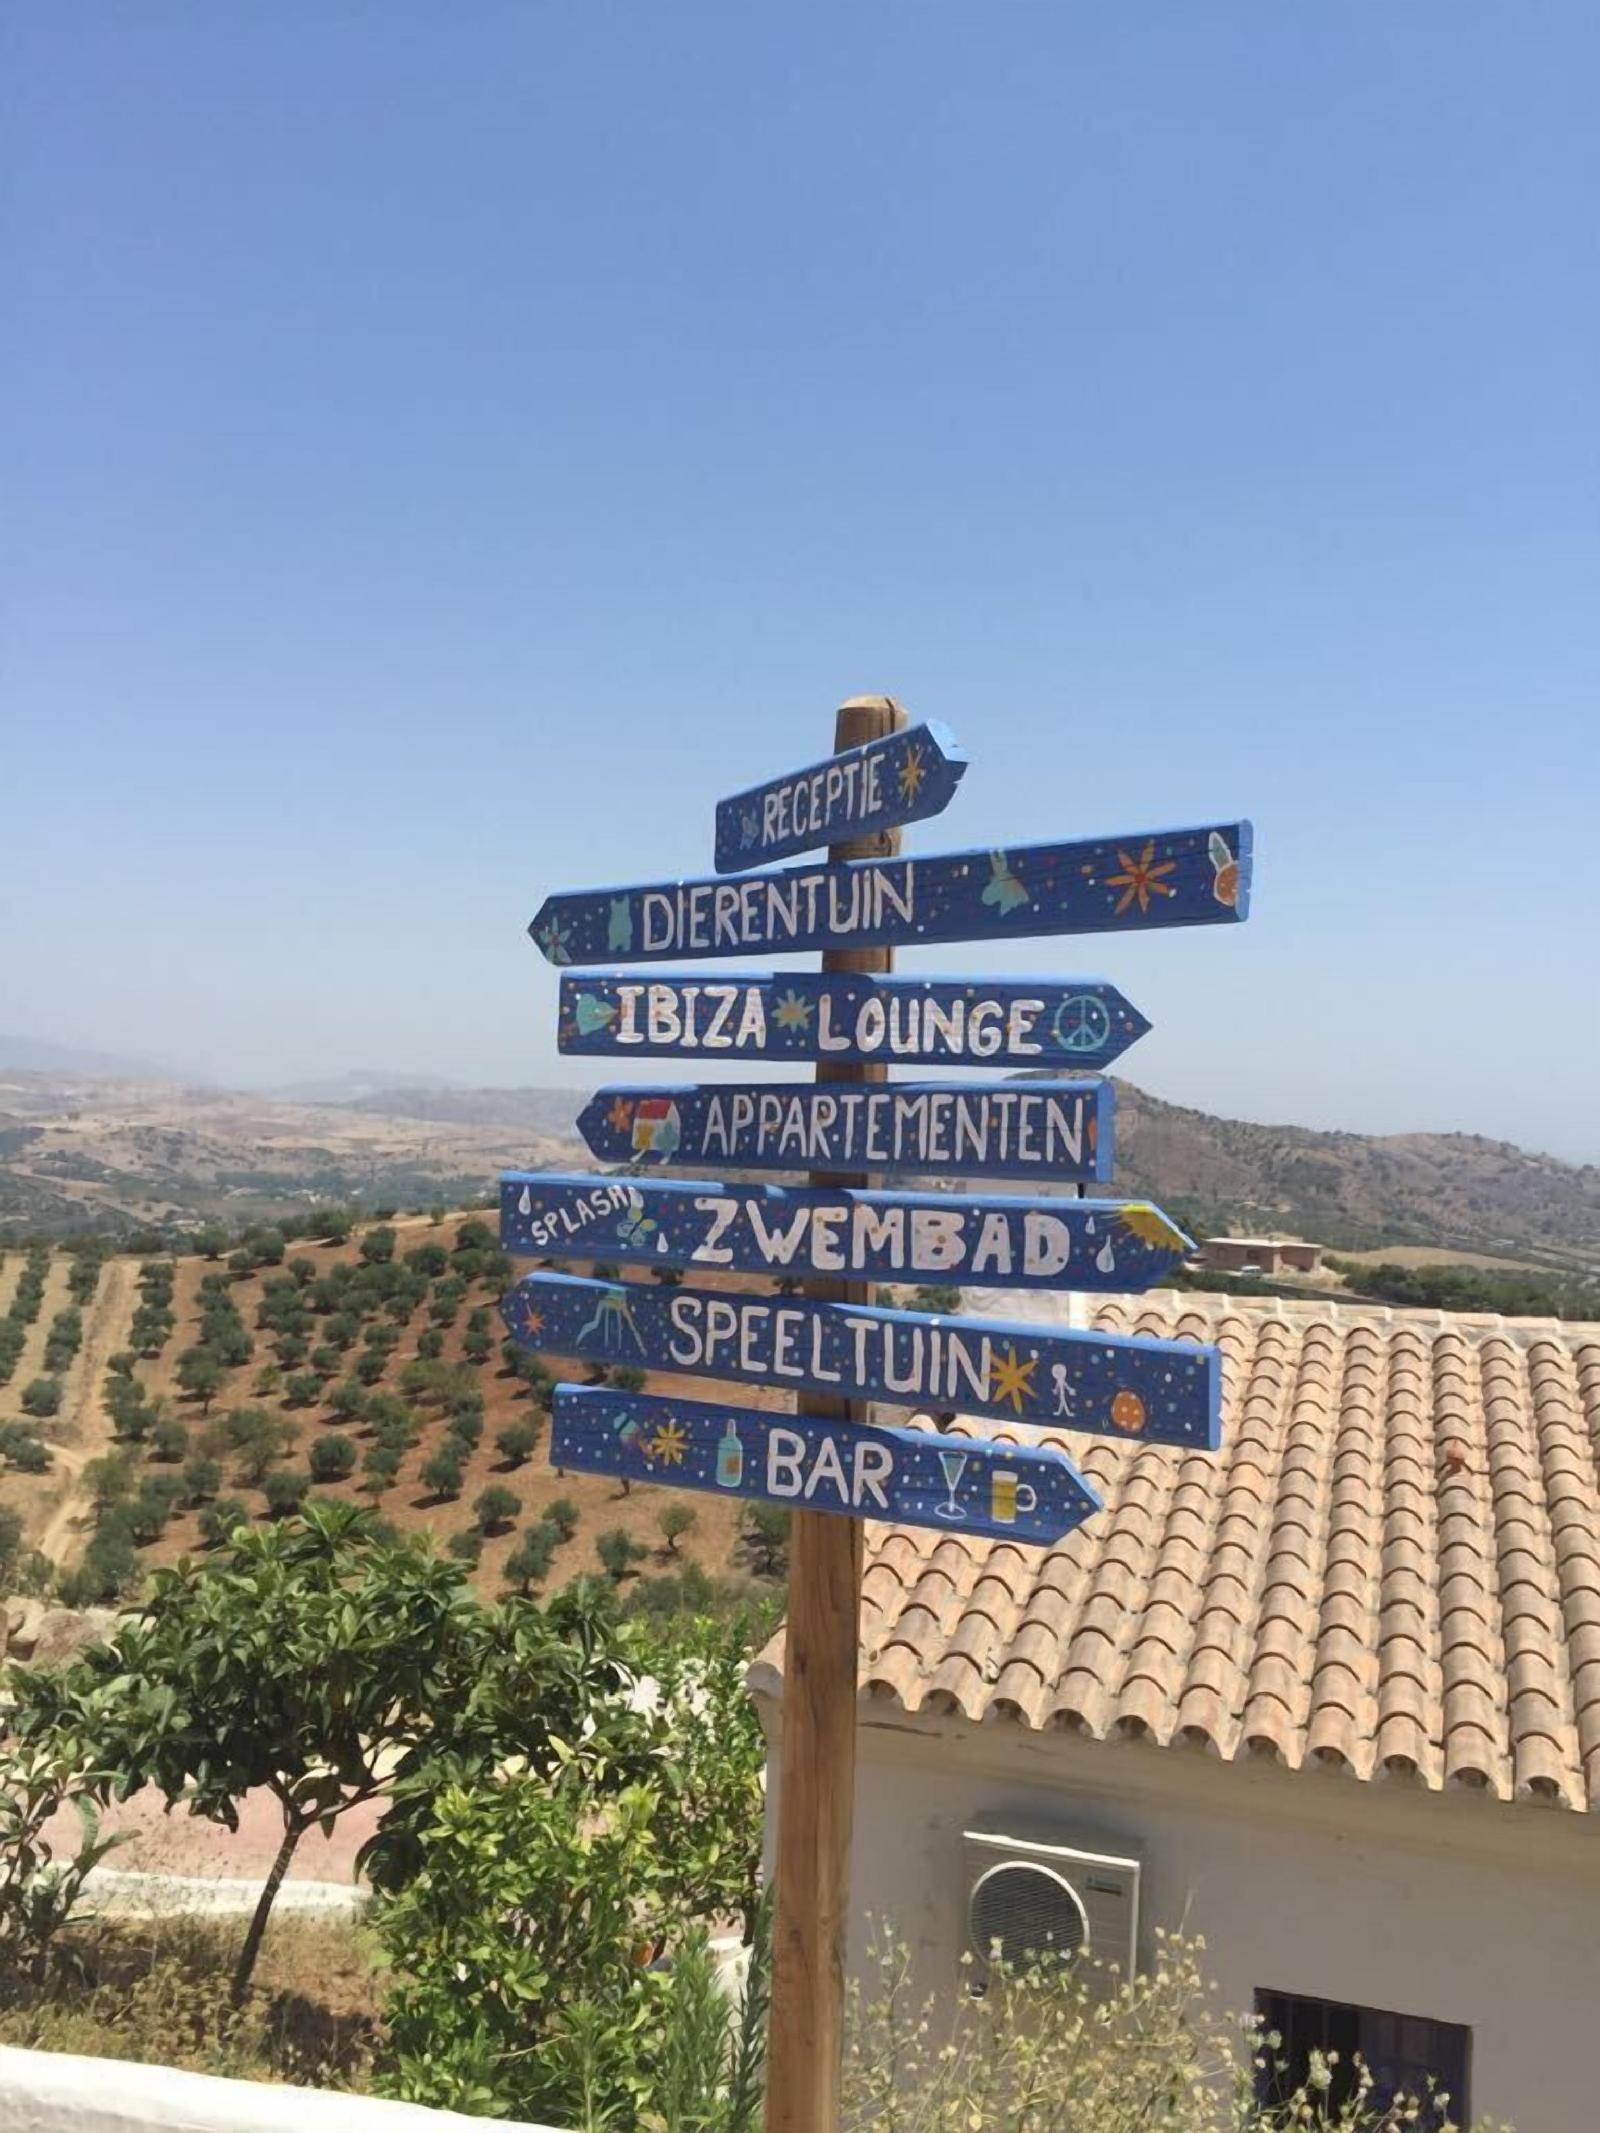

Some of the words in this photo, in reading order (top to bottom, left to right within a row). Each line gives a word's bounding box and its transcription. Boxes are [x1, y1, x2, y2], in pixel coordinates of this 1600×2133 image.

[762, 747, 886, 845] RECEPTIE
[642, 863, 914, 951] DIERENTUIN
[615, 985, 767, 1047] IBIZA
[816, 993, 1045, 1056] LOUNGE
[702, 1094, 1083, 1164] APPARTEMENTEN
[691, 1198, 1070, 1277] ZWEMBAD
[669, 1297, 990, 1402] SPEELTUIN
[766, 1427, 894, 1509] BAR
